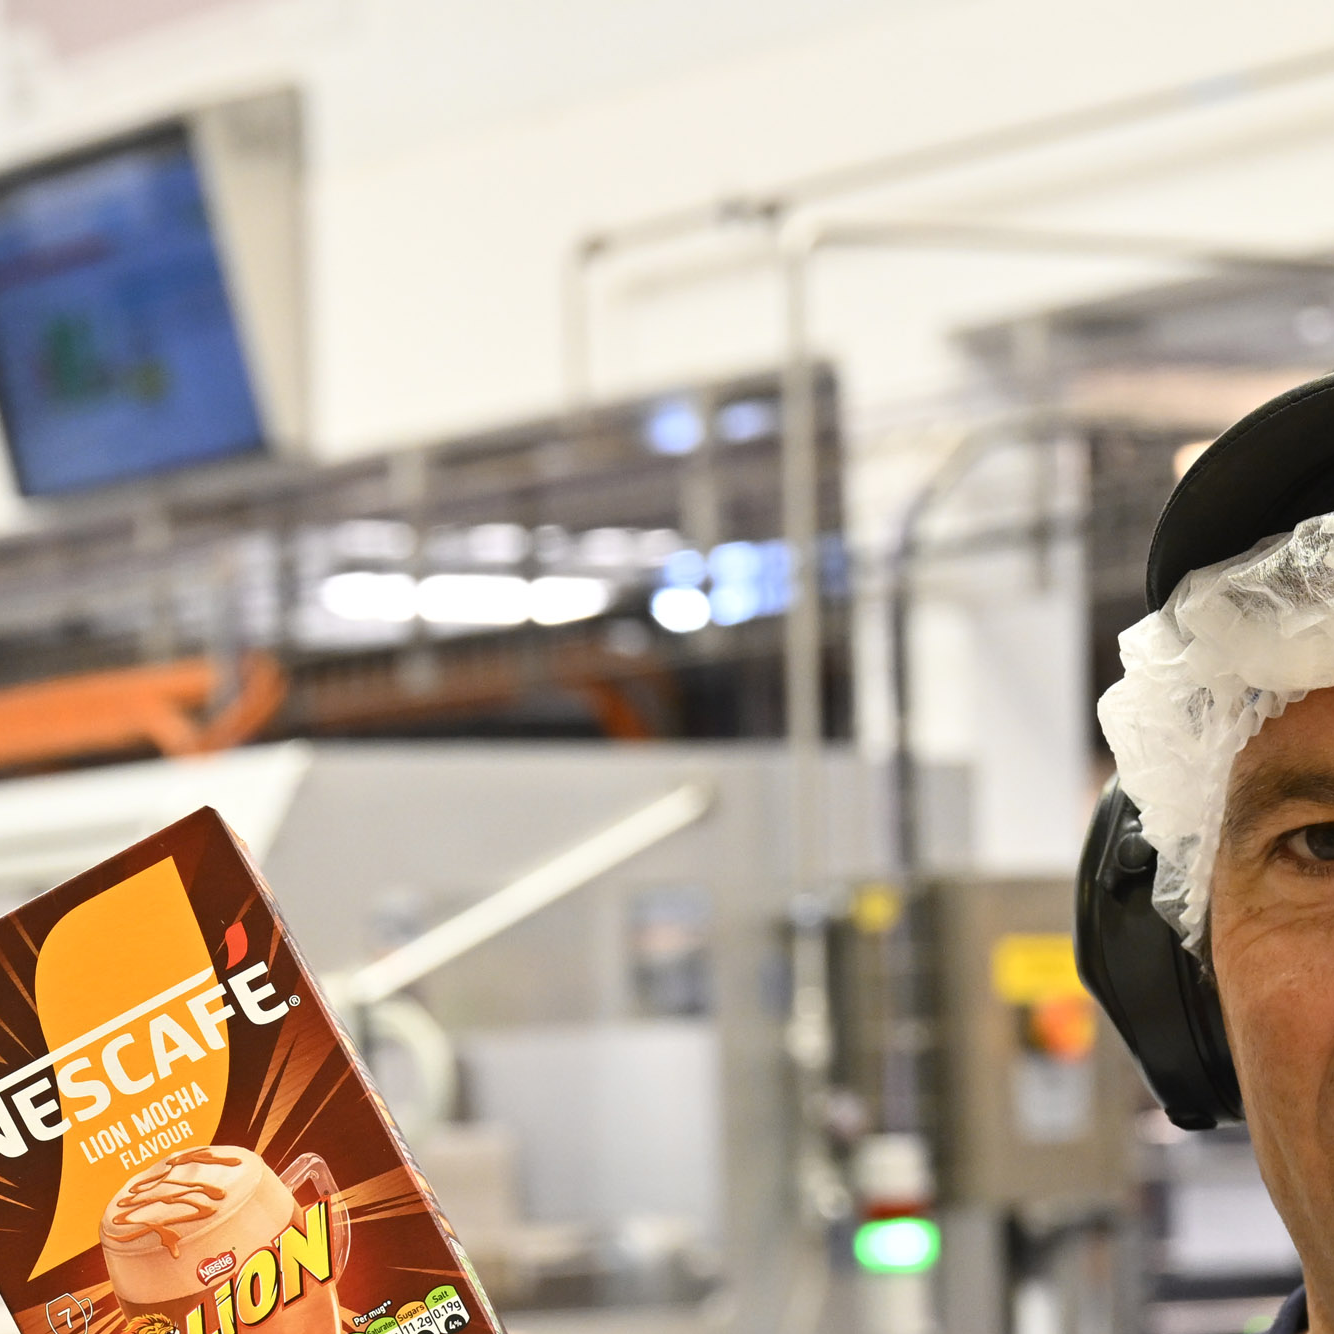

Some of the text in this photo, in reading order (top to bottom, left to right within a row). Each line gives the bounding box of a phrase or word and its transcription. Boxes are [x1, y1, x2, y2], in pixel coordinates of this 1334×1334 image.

[79, 1081, 209, 1164] LION MOCHA
[119, 1120, 193, 1170] FLAVOUR
[433, 1291, 449, 1303] Salt
[57, 1308, 73, 1329] 7
[397, 1304, 425, 1322] Sugars
[433, 1300, 462, 1319] 0.19g
[353, 1315, 368, 1326] Per
[403, 1315, 433, 1334] 11.2g
[449, 1320, 462, 1330] 4%
